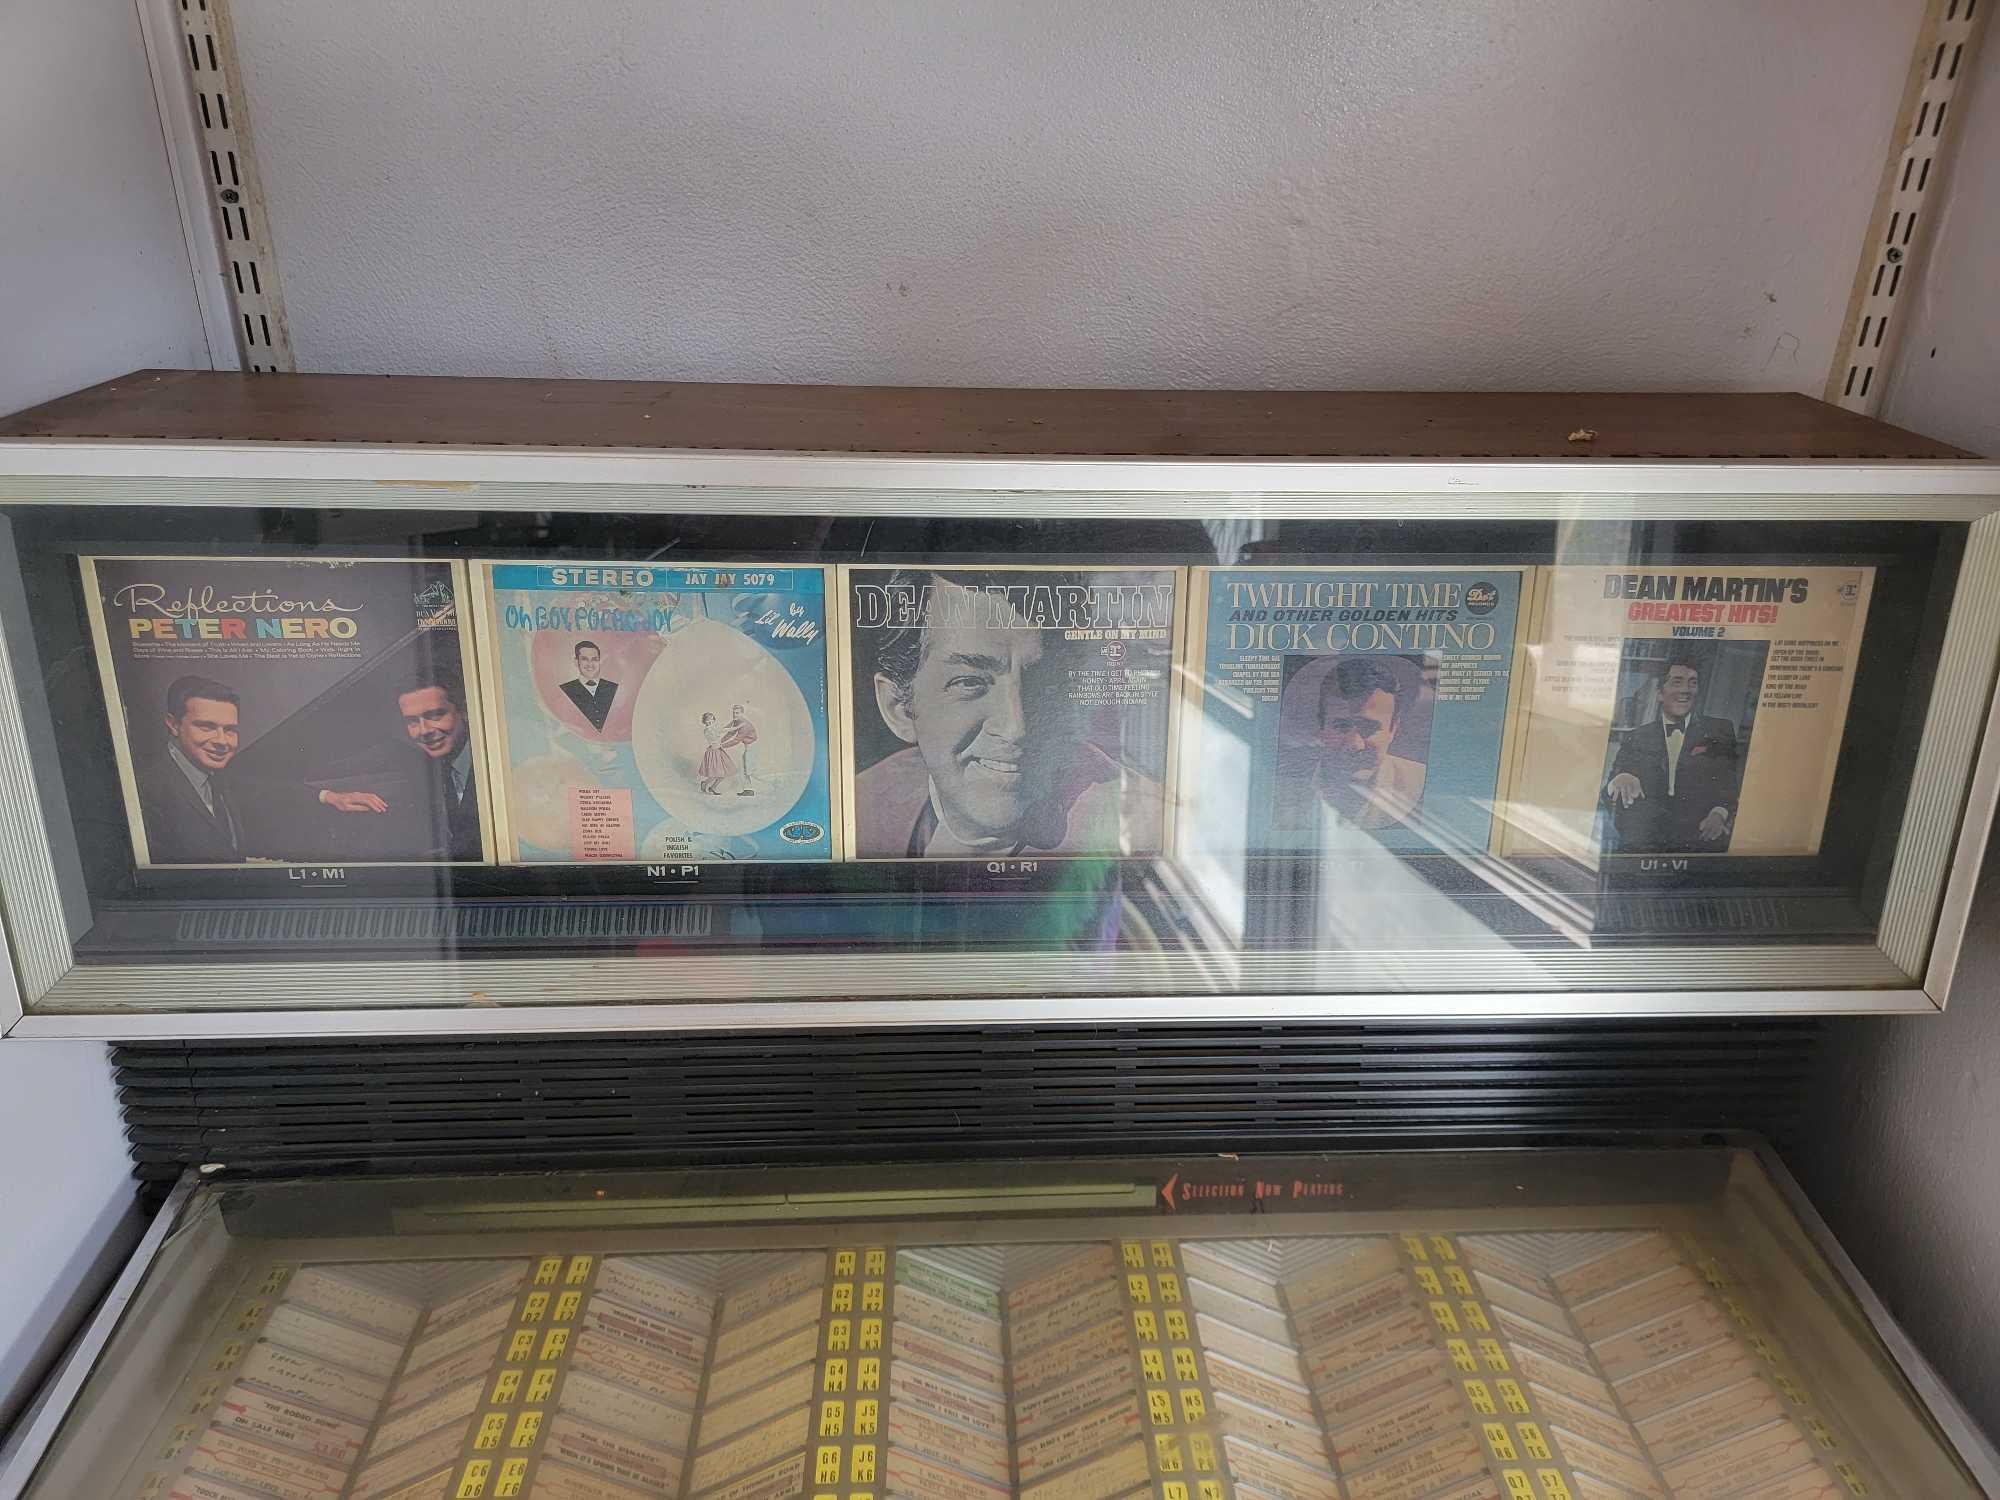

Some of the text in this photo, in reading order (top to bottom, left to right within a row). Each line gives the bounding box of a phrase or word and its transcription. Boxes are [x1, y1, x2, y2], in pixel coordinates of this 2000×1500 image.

[551, 568, 654, 586] STEREO
[685, 573, 775, 586] JAY JAY 5079
[1604, 574, 1808, 603] DEAN MARTIN'S
[114, 583, 363, 619] Reflections
[1227, 582, 1462, 609] TWILIGHT TIME
[789, 602, 805, 617] by
[855, 585, 1172, 629] DEAN MARTIN
[1229, 609, 1458, 622] AND OTHER GOLDEN HITS
[1627, 602, 1778, 625] GREATEST HITS!
[128, 618, 358, 639] PETER NERO
[771, 619, 819, 645] Wally
[1064, 629, 1168, 640] GENTLE ON MY MIND
[1672, 626, 1726, 637] VOLUME 2
[1226, 623, 1496, 650] DICK CONTINO
[647, 866, 700, 878] N1 P1
[986, 861, 1038, 873] Q1 R1
[288, 868, 345, 880] L1 M1
[1130, 1281, 1143, 1291] L2
[836, 1289, 850, 1299] G2
[868, 1288, 881, 1298] J2
[1136, 1317, 1151, 1327] L3
[1168, 1316, 1184, 1327] N3
[833, 1326, 847, 1337] G3
[866, 1325, 880, 1335] J3
[551, 1334, 566, 1345] E3
[1143, 1354, 1159, 1366] L4
[1176, 1354, 1192, 1366] N4
[829, 1365, 844, 1377] G4
[863, 1364, 877, 1375] J4
[1180, 1370, 1195, 1381] P4
[503, 1375, 518, 1387] C4
[1145, 1371, 1162, 1381] M4
[828, 1381, 843, 1393] H4
[862, 1380, 877, 1391] K4
[1151, 1394, 1167, 1407] L5
[1185, 1395, 1202, 1408] N5
[826, 1407, 841, 1419] G5
[861, 1405, 876, 1417] J5
[524, 1417, 540, 1429] E5
[1152, 1412, 1171, 1424] M5
[488, 1418, 504, 1431] C5
[824, 1423, 840, 1436] H5
[860, 1422, 875, 1434] K5
[481, 1436, 498, 1448] D5
[518, 1434, 535, 1447] F5
[822, 1452, 838, 1465] G6
[858, 1450, 874, 1463] J6
[471, 1465, 488, 1478] C6
[508, 1463, 525, 1476] E6
[820, 1469, 836, 1482] H6
[857, 1468, 873, 1481] K6
[1507, 1476, 1525, 1489] Q7
[1541, 1474, 1559, 1487] S7
[464, 1484, 482, 1497] D6
[502, 1482, 520, 1496] F6
[1168, 1487, 1183, 1500] L7
